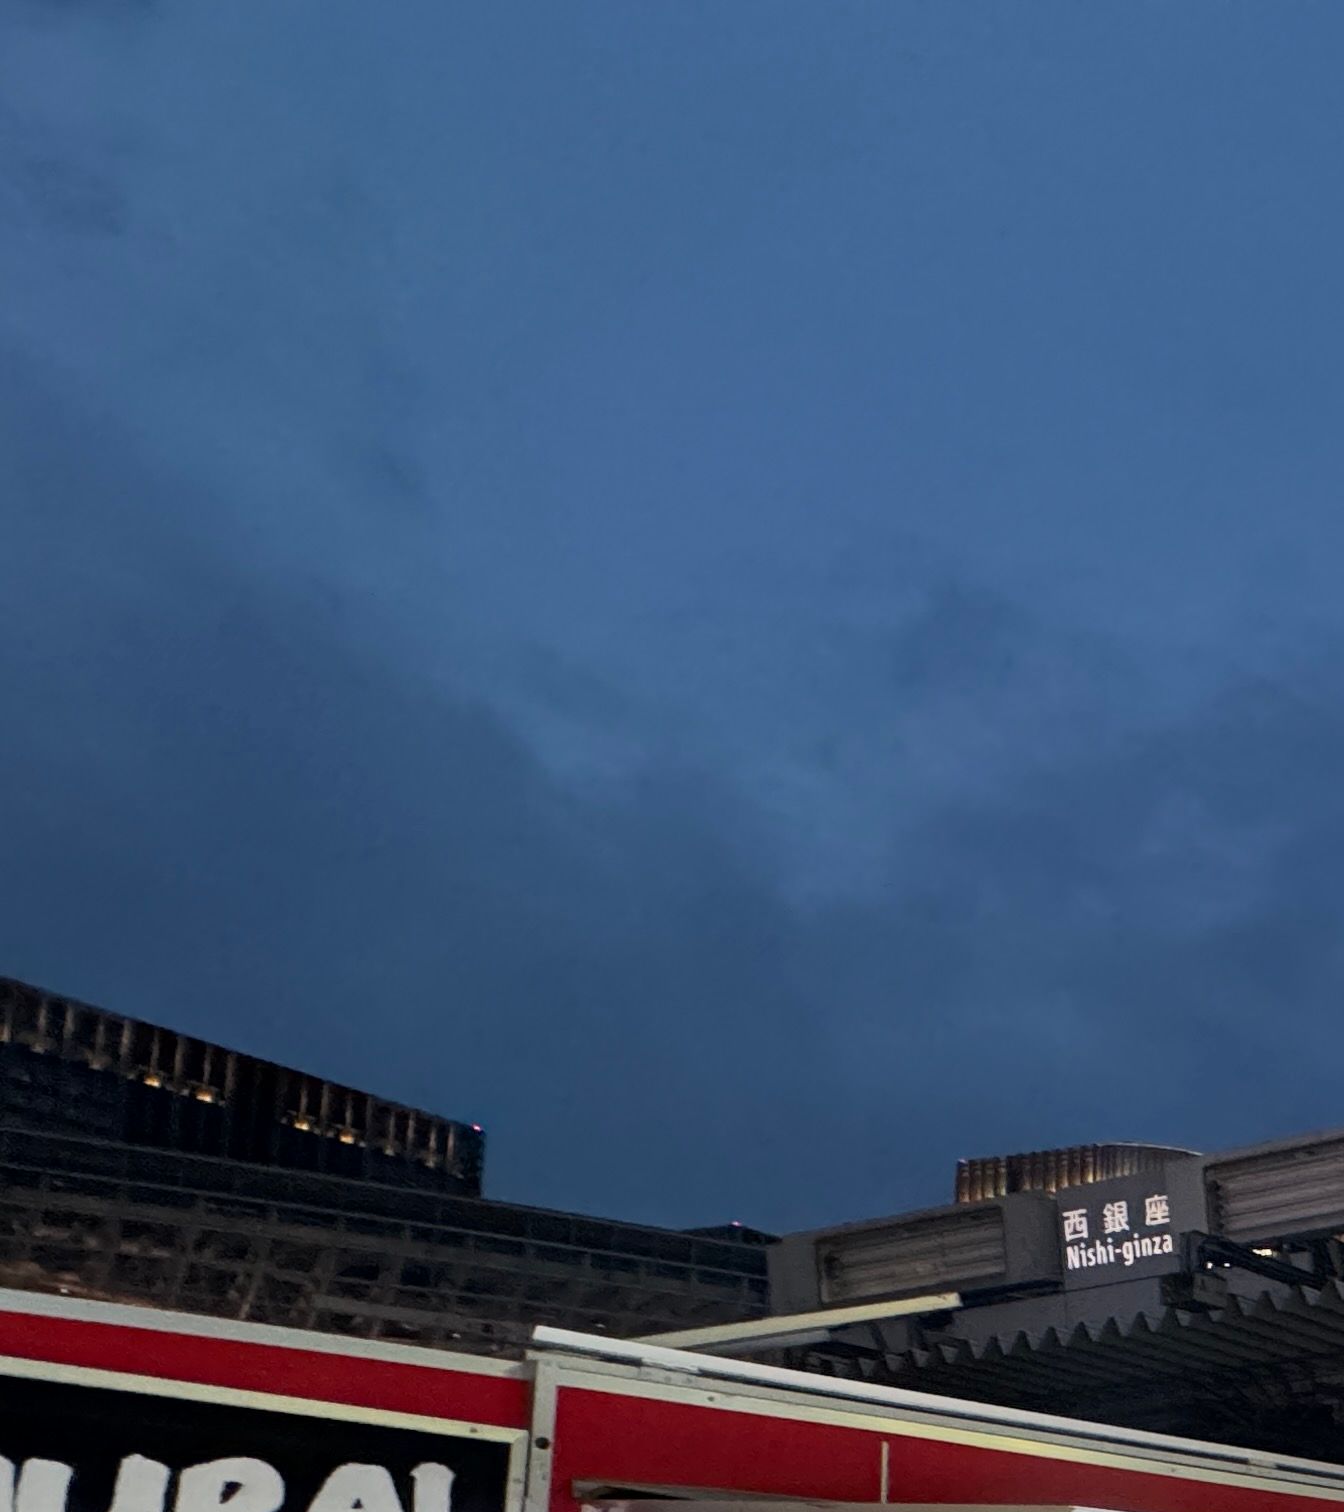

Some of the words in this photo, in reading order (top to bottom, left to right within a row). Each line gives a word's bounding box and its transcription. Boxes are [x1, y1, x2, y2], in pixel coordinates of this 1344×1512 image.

[1062, 1194, 1170, 1242] 西銀座
[1066, 1233, 1173, 1270] Nishi-ginza
